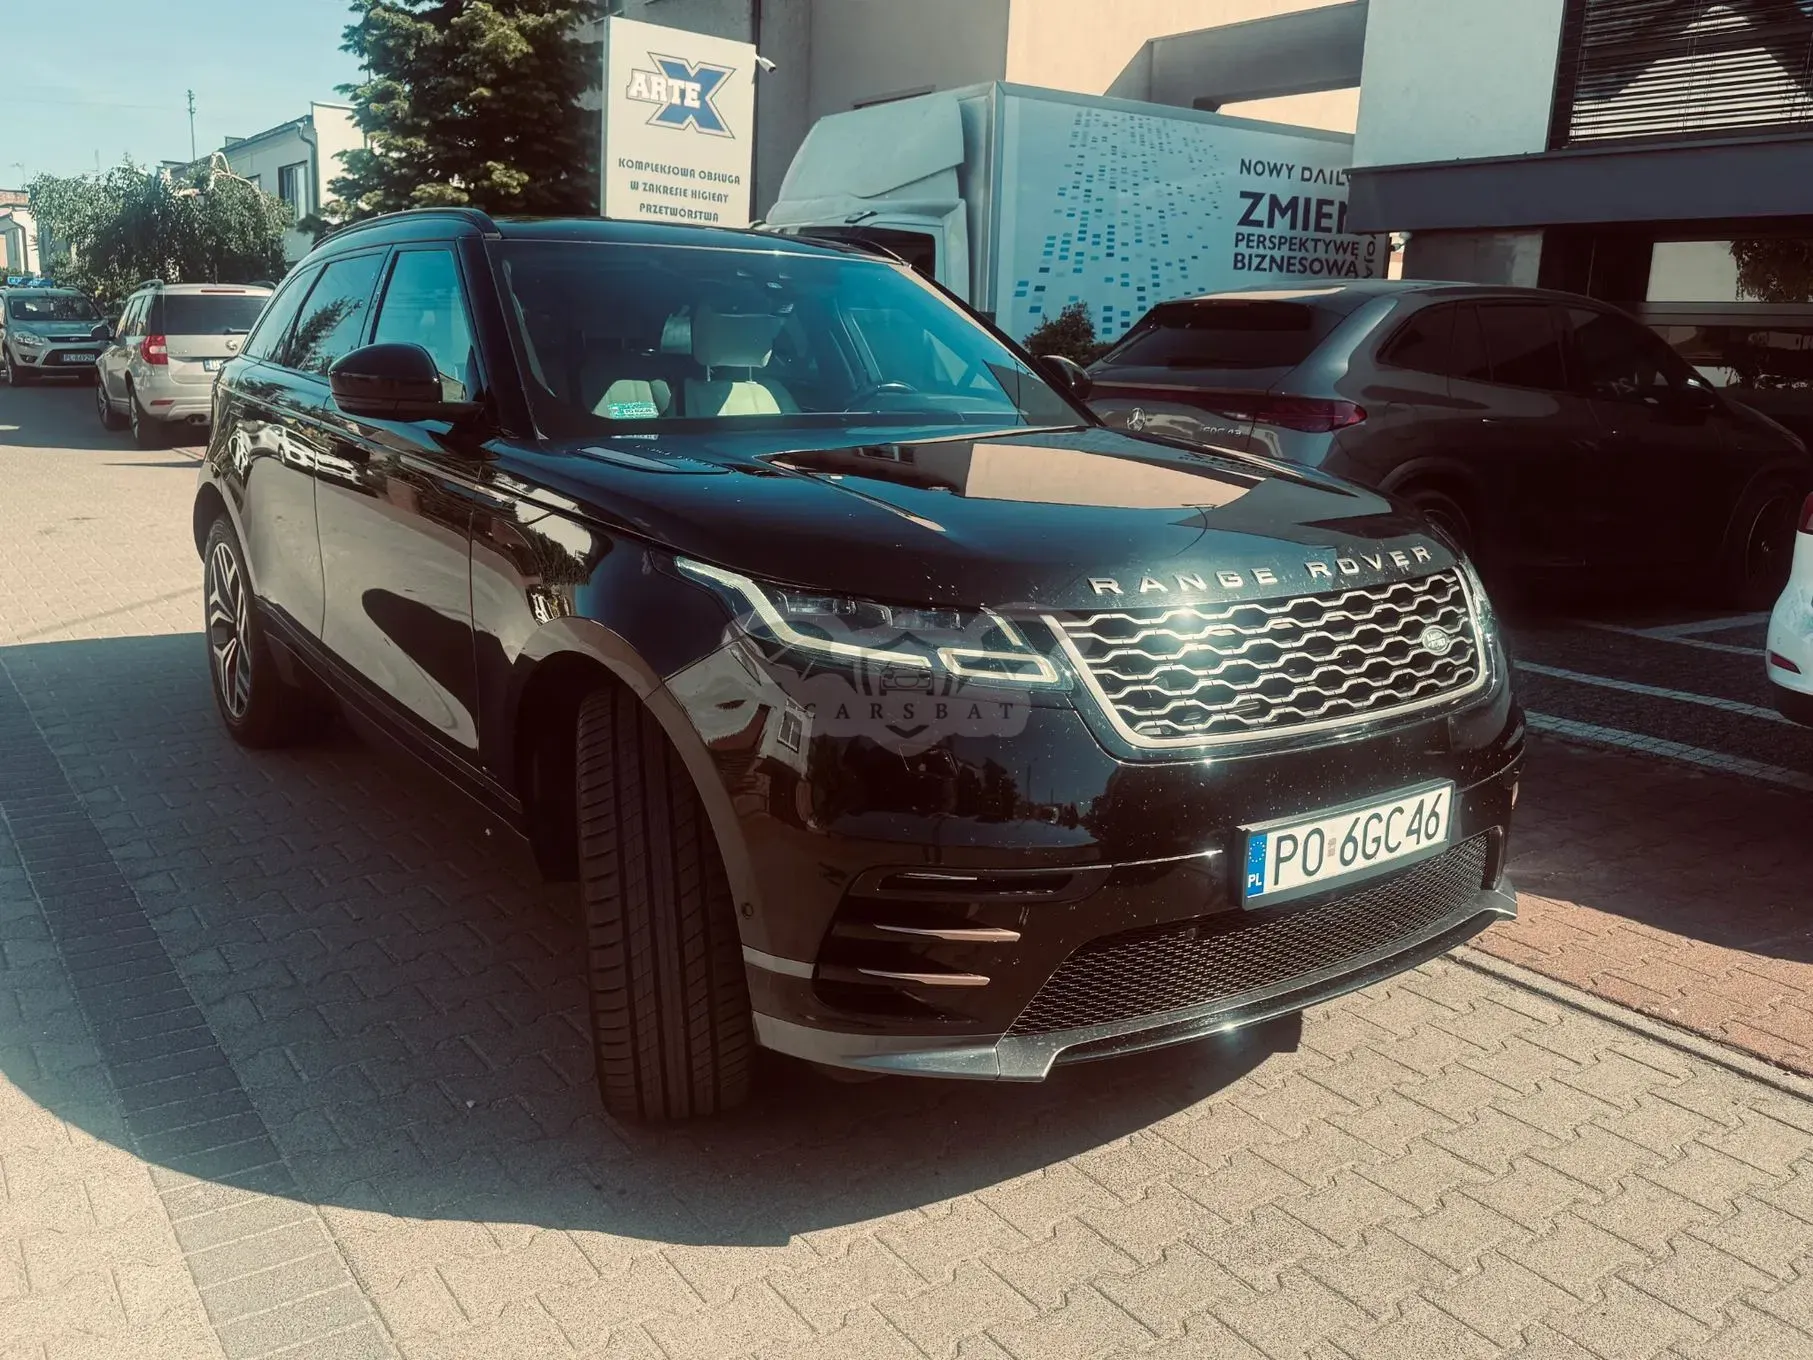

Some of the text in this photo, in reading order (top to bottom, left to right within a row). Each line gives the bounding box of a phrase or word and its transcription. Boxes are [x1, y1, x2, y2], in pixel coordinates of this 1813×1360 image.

[618, 157, 696, 178] KOMPLEKSOWA
[1239, 158, 1295, 180] NOWY
[630, 180, 729, 204] W ZAKRESIE HIGIENY
[1234, 232, 1360, 260] PERSPEKTYWĘ
[1087, 545, 1432, 596] RANGE ROVER
[1273, 793, 1443, 886] PO 6GC46
[1247, 873, 1262, 888] PL
